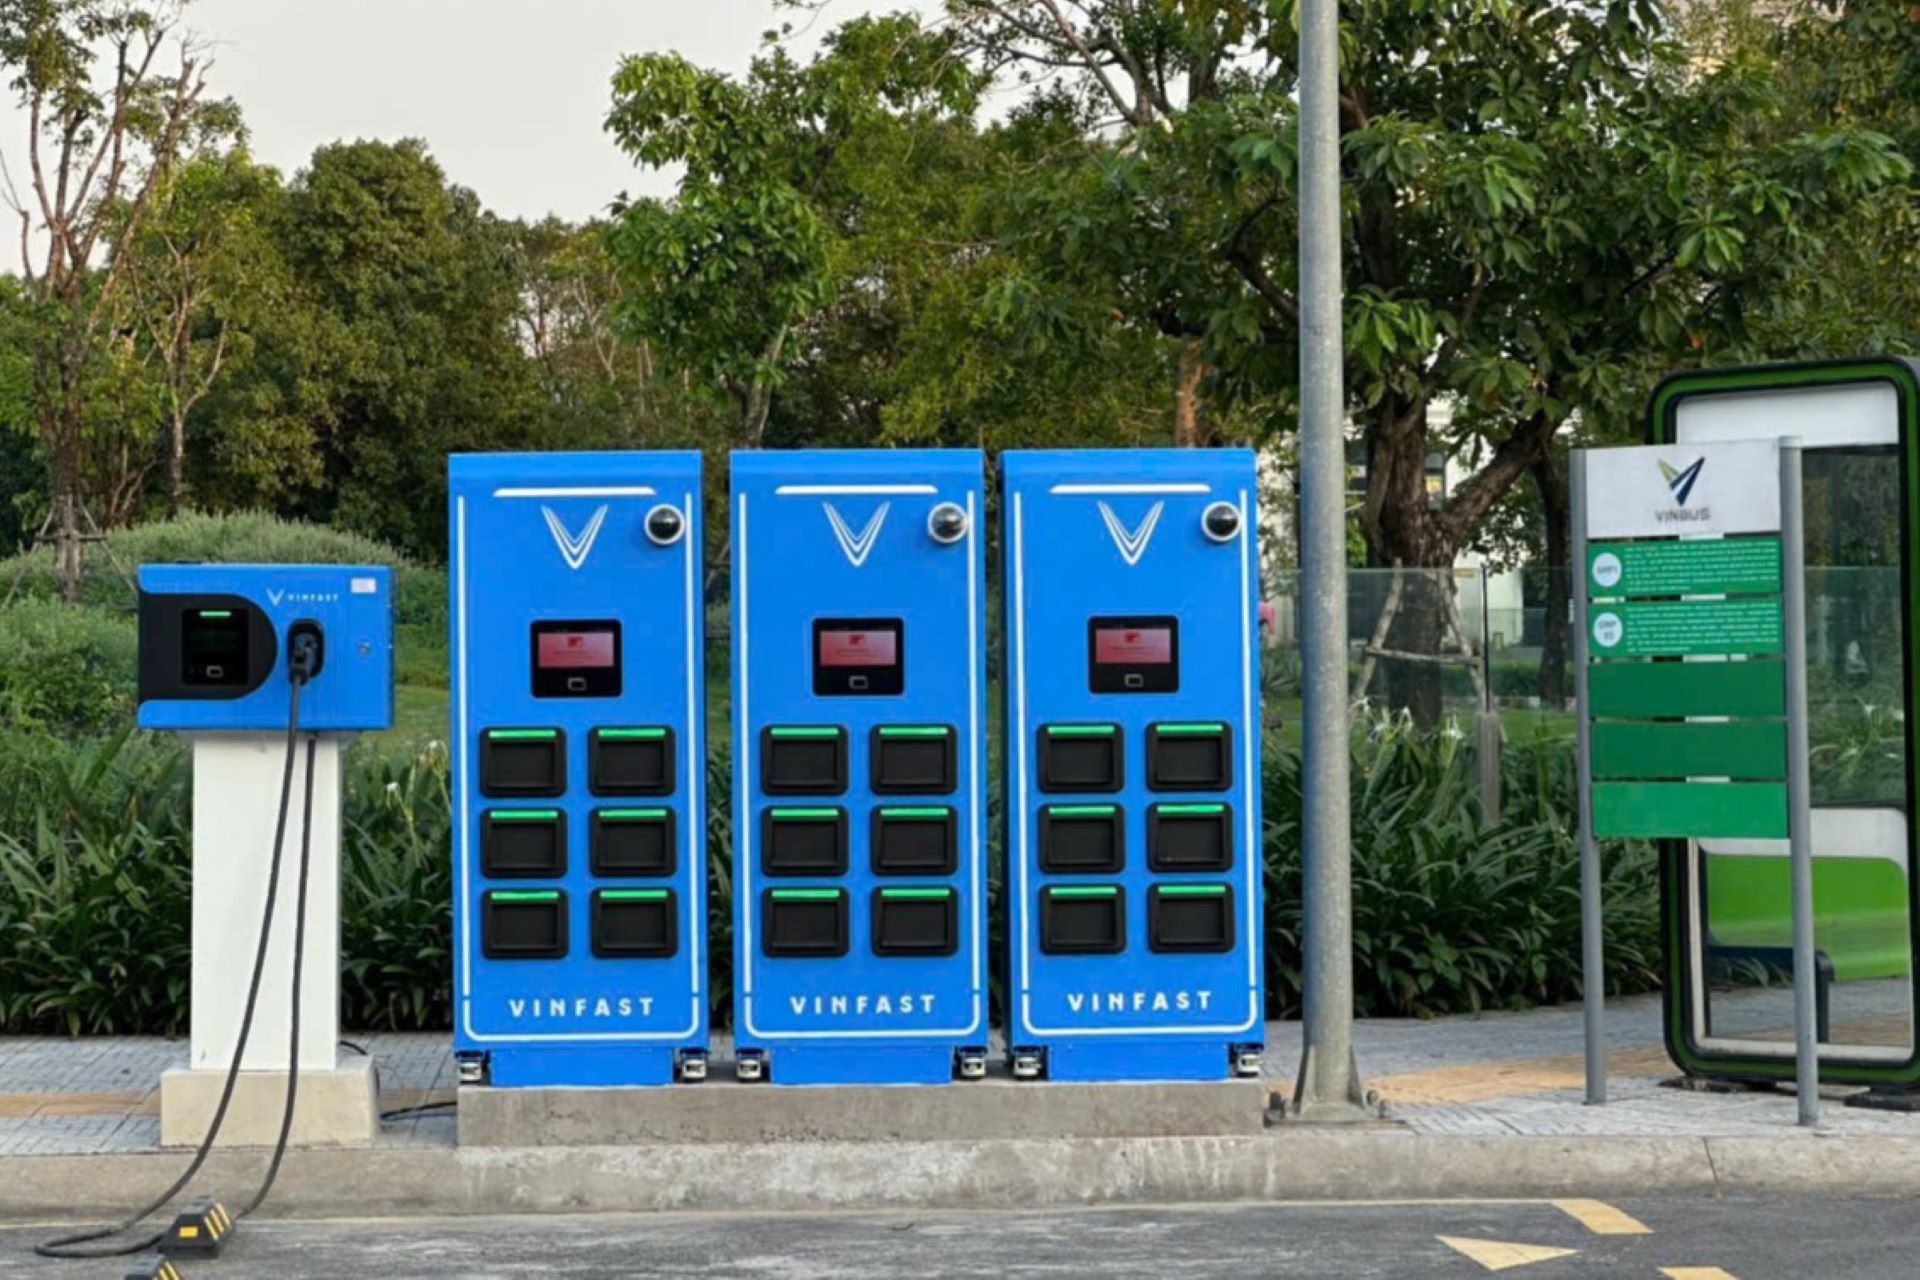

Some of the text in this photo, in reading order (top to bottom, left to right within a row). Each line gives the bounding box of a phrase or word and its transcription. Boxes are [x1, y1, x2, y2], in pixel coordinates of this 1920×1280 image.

[509, 997, 655, 1018] VINFAST
[791, 994, 935, 1014] VINFAST
[1068, 990, 1211, 1011] VINFAST
